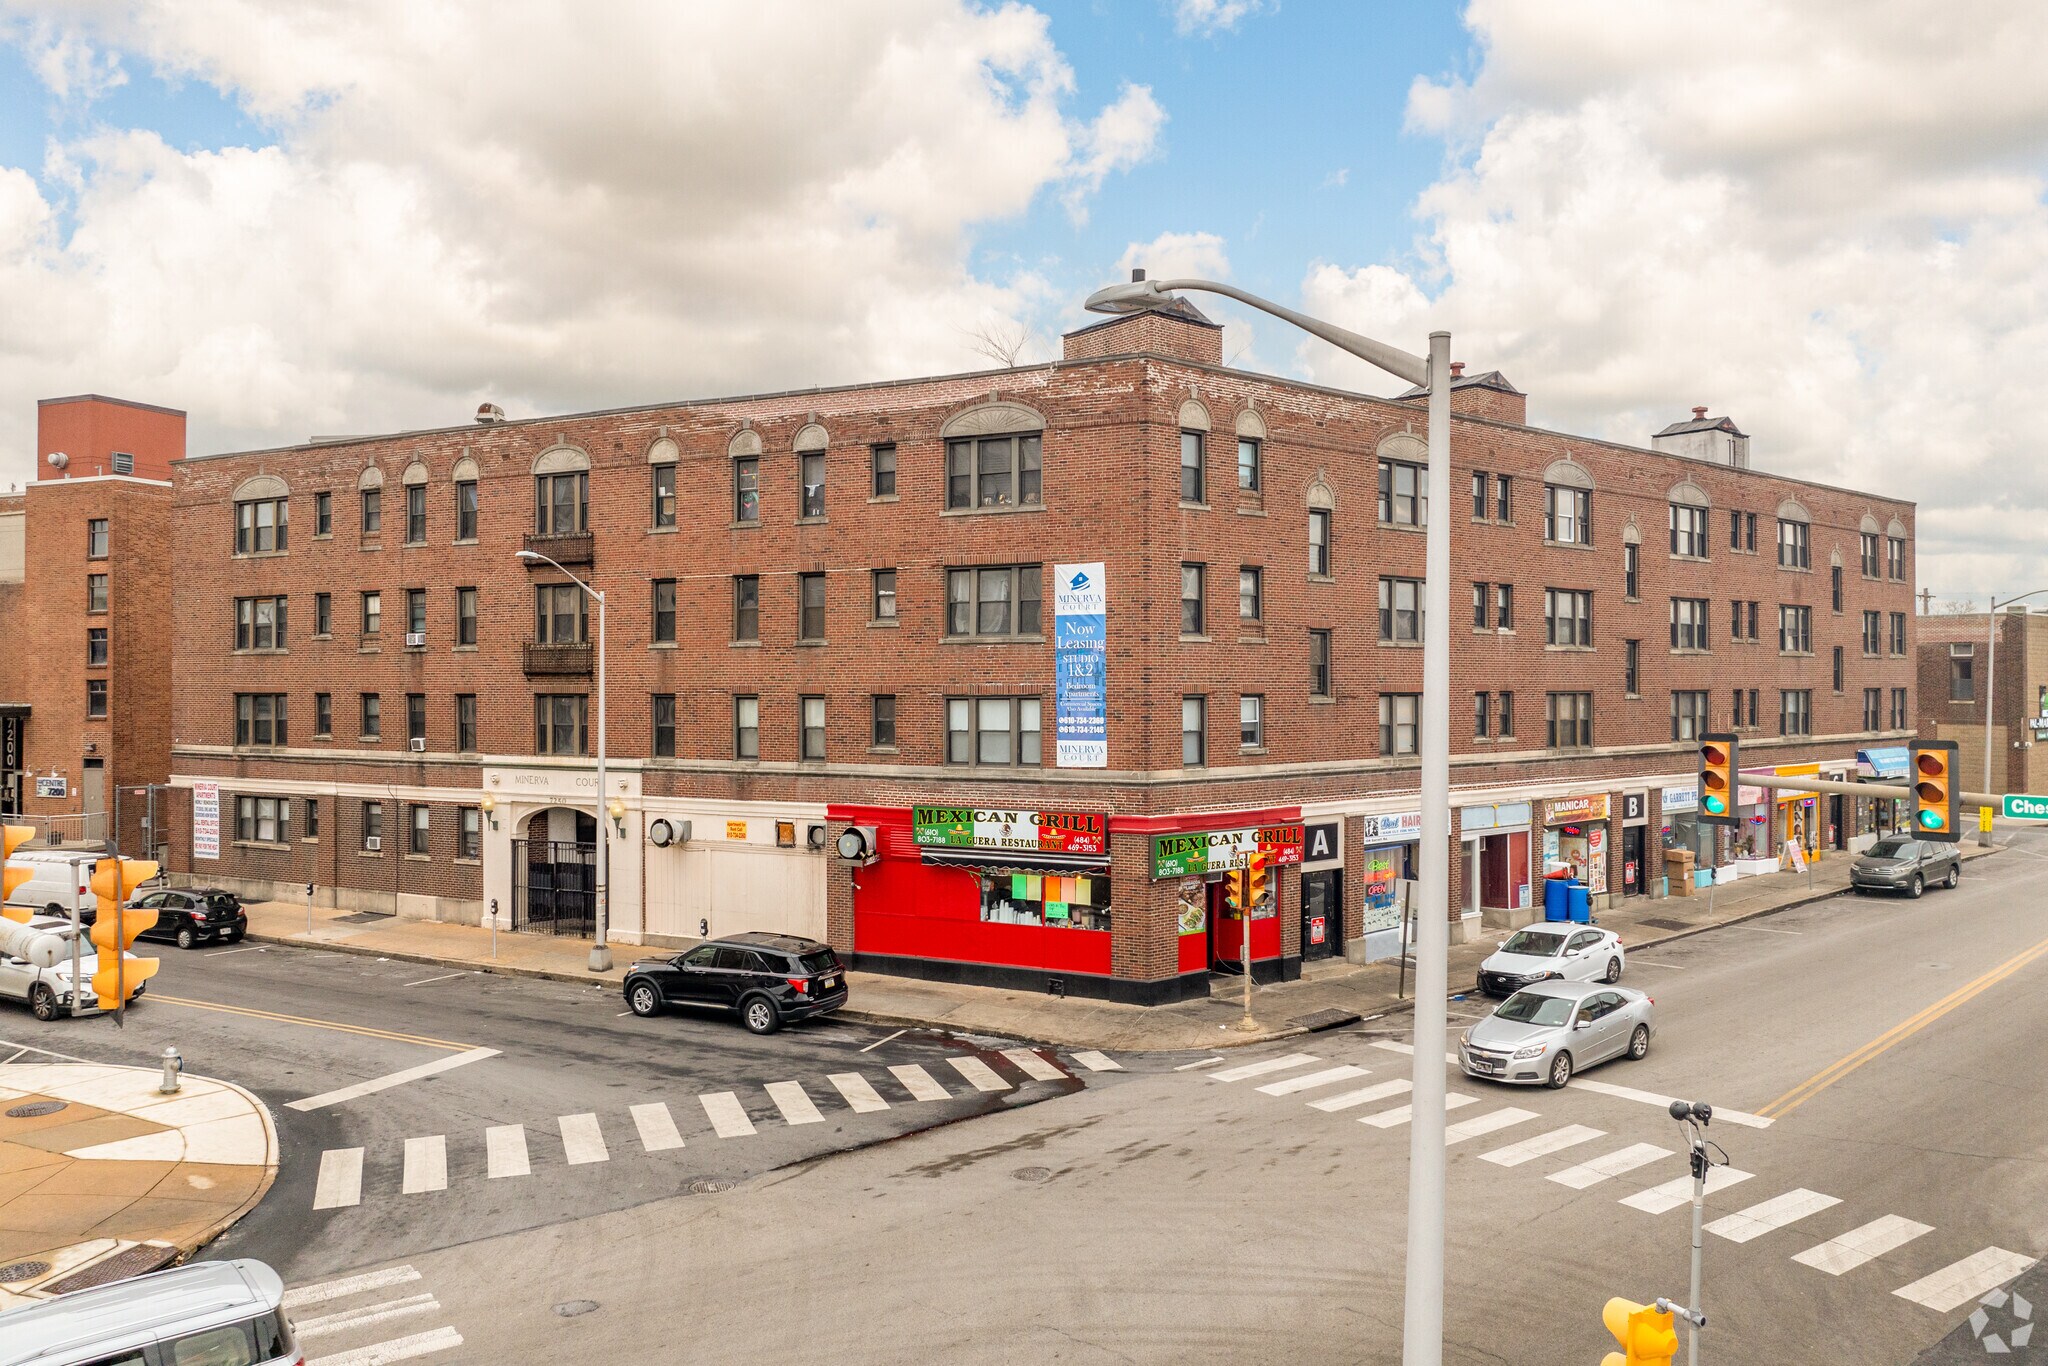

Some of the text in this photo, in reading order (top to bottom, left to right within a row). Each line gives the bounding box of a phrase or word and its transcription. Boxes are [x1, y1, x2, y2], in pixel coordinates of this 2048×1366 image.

[1058, 594, 1102, 603] MINERVA
[1065, 621, 1096, 635] Now
[1057, 635, 1105, 652] Leasing
[1062, 654, 1099, 663] STUDIO
[1065, 682, 1096, 690] Bedroom
[1063, 690, 1100, 698] Apartments
[1059, 744, 1104, 754] MINERVA
[1063, 754, 1099, 762] COURT
[42, 779, 65, 788] CENTRE
[515, 775, 599, 787] MINERVA COUR
[48, 787, 65, 797] 7200
[1669, 792, 1690, 803] GARRETT
[1554, 799, 1589, 812] MANICAR
[1628, 797, 1638, 817] B
[2011, 799, 2048, 815] Che
[917, 809, 1100, 834] MEXICAN GRILL
[1401, 815, 1421, 828] HAIR
[924, 828, 939, 837] (610)
[917, 835, 946, 844] 803-7188
[950, 835, 1063, 851] LA GUERA RESTAURANT
[1073, 835, 1090, 844] (484)
[1159, 826, 1302, 858] MEXICAN GRILL
[1311, 829, 1329, 856] A
[1067, 843, 1097, 852] 469-3153
[1165, 860, 1178, 868] (610)
[1187, 863, 1198, 872] LA
[1201, 860, 1226, 871] GUERA
[1367, 859, 1390, 872] Best
[1158, 866, 1184, 876] 803-7188
[1368, 883, 1387, 895] OPEN
